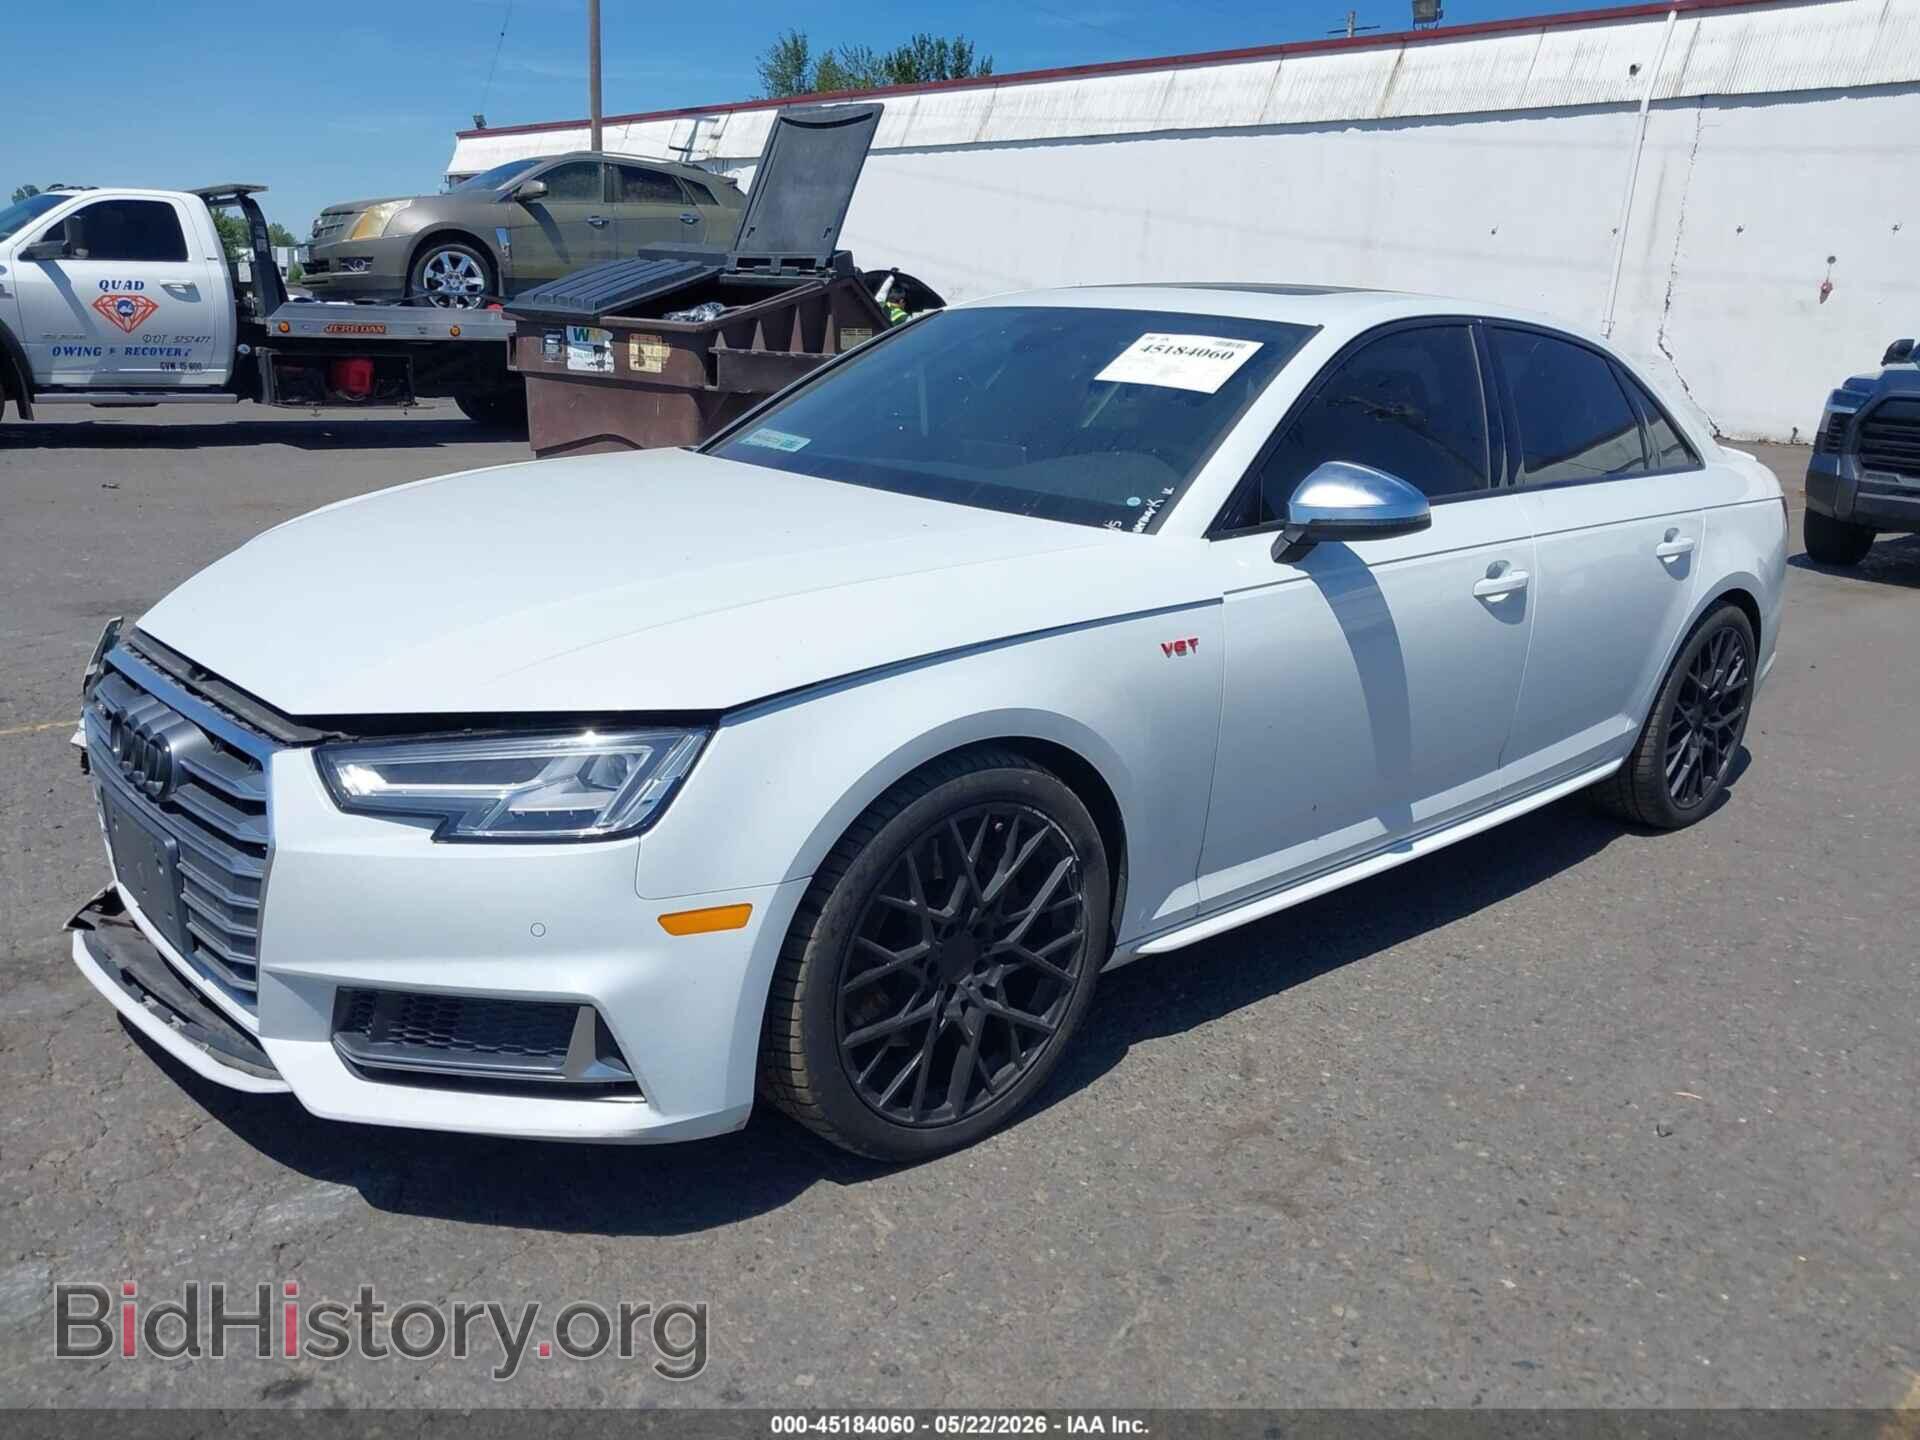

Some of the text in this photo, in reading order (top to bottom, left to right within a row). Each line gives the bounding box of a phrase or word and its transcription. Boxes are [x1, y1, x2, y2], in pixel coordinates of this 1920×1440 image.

[99, 280, 144, 292] QUAD
[52, 346, 101, 357] OWING
[1140, 344, 1235, 360] 45184060
